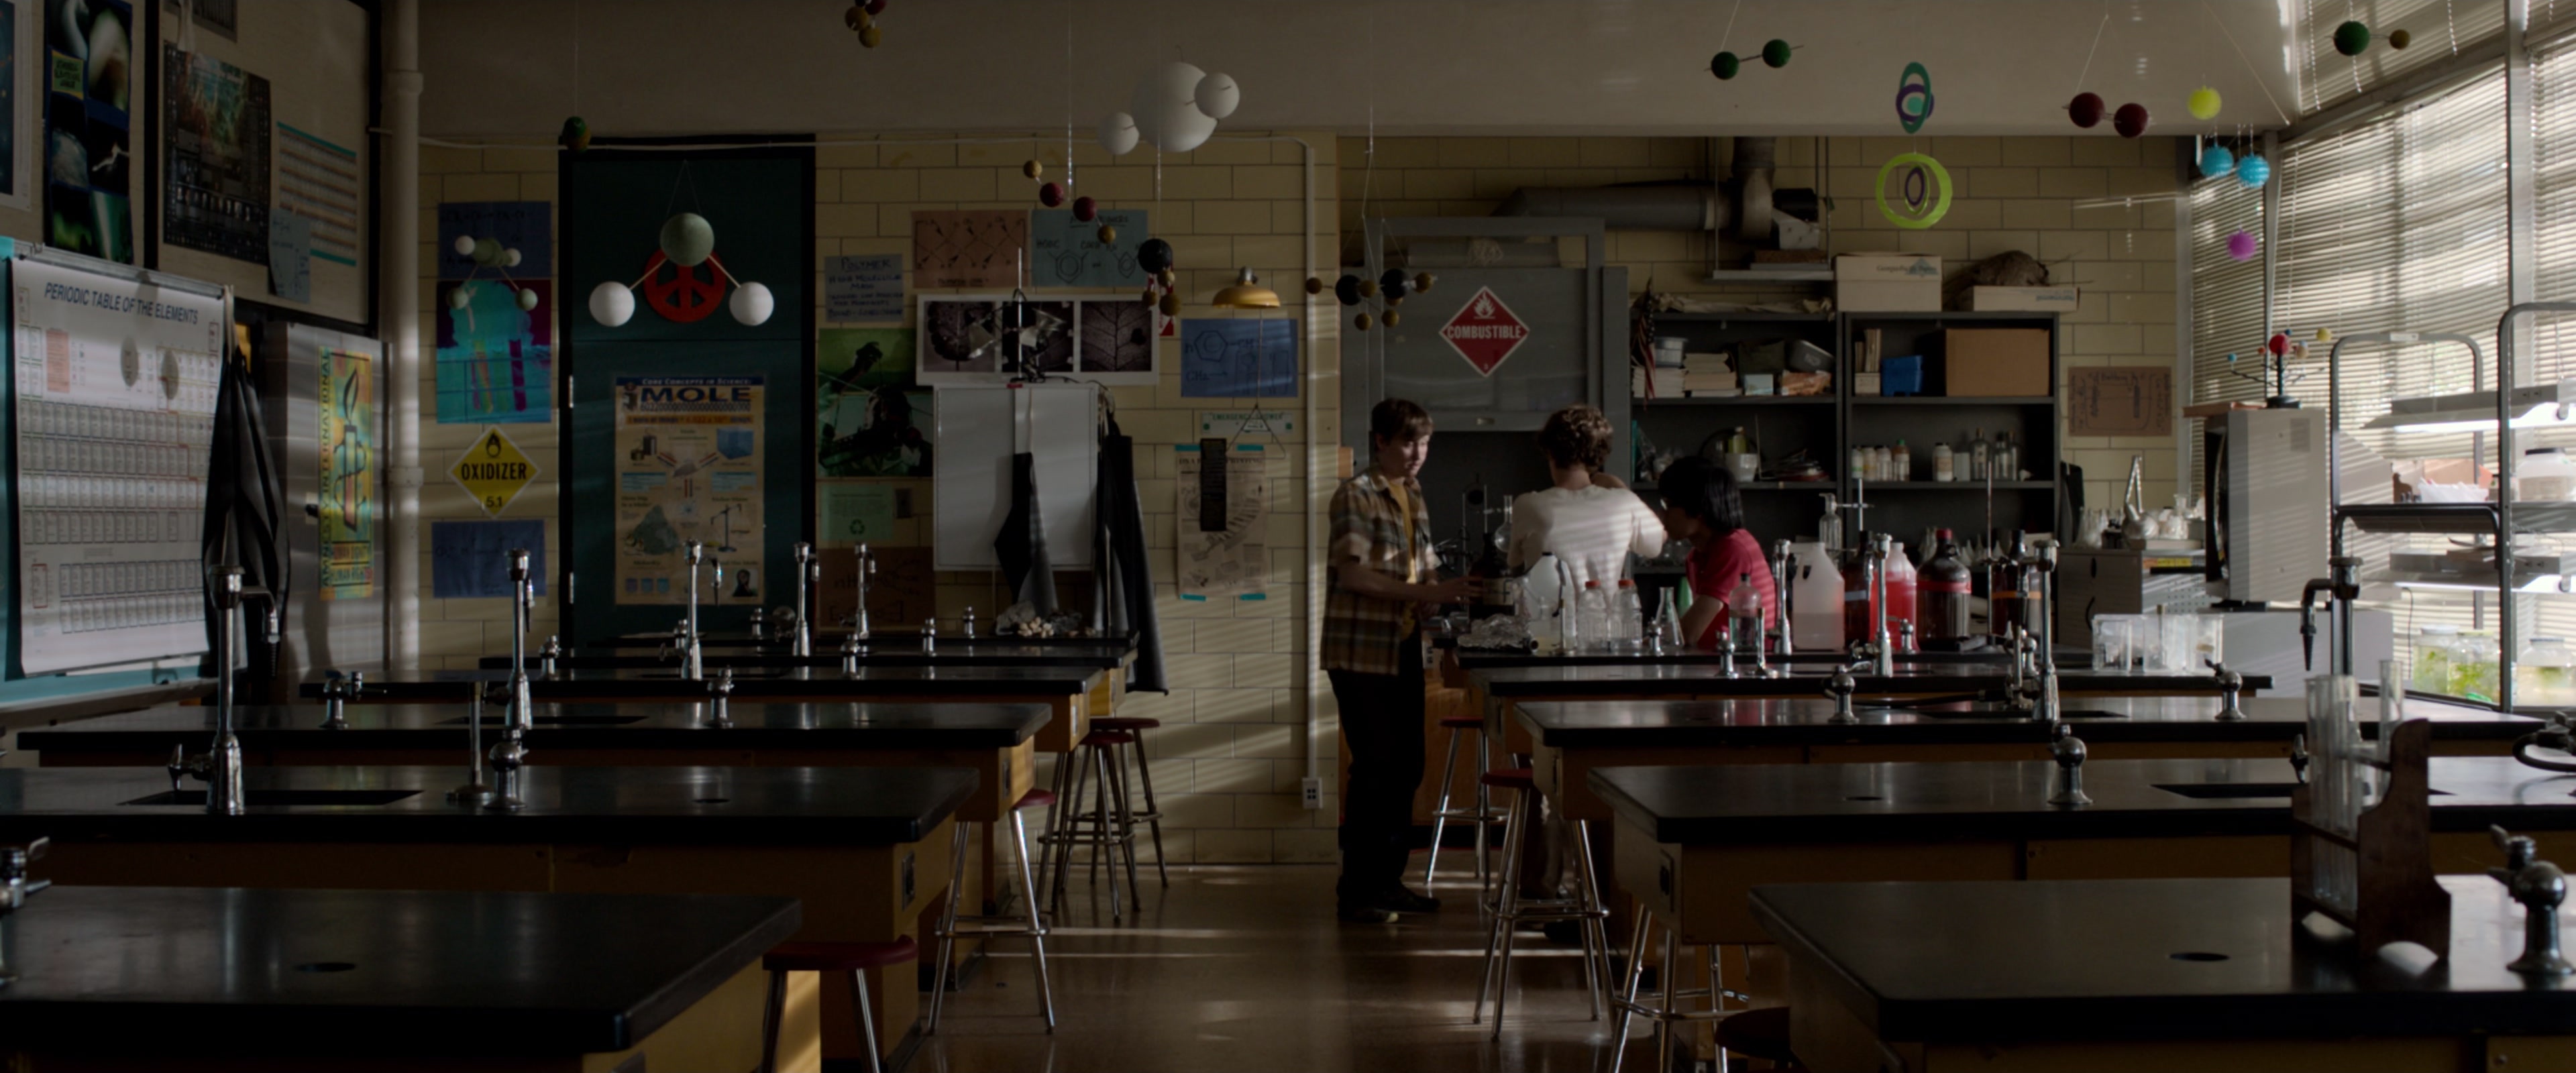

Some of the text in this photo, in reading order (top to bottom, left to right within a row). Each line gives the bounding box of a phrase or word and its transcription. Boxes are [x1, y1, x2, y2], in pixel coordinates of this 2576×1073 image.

[841, 257, 891, 270] POLYMER
[44, 282, 199, 325] PERIODIC TABLE OF THE ELEMENTS
[1448, 325, 1521, 339] COMBUSTIBLE
[641, 387, 751, 402] MOLE
[320, 352, 333, 587] AMNESTY INTERNATIONAL
[461, 462, 527, 481] OXIDIZER
[486, 496, 502, 508] 5.1
